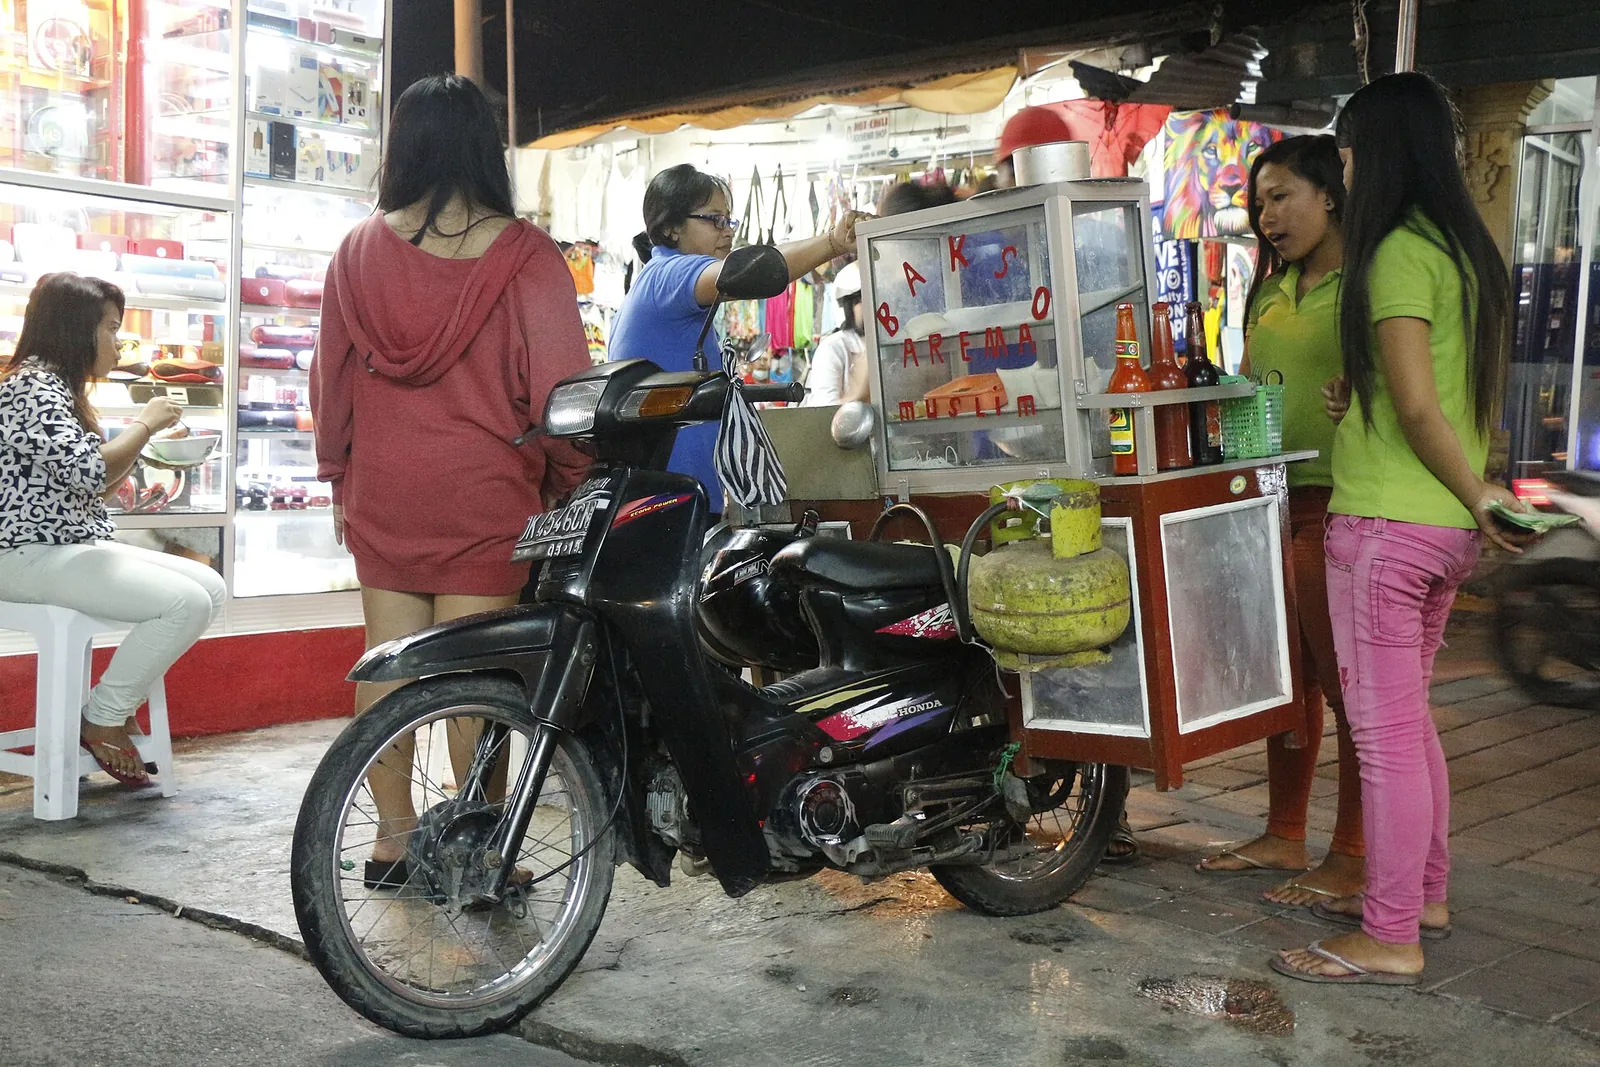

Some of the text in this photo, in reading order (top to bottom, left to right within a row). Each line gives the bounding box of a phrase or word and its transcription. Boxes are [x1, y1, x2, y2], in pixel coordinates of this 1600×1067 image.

[876, 234, 1051, 337] BAKSO
[903, 323, 1037, 368] AREMA
[898, 699, 943, 718] HONDA
